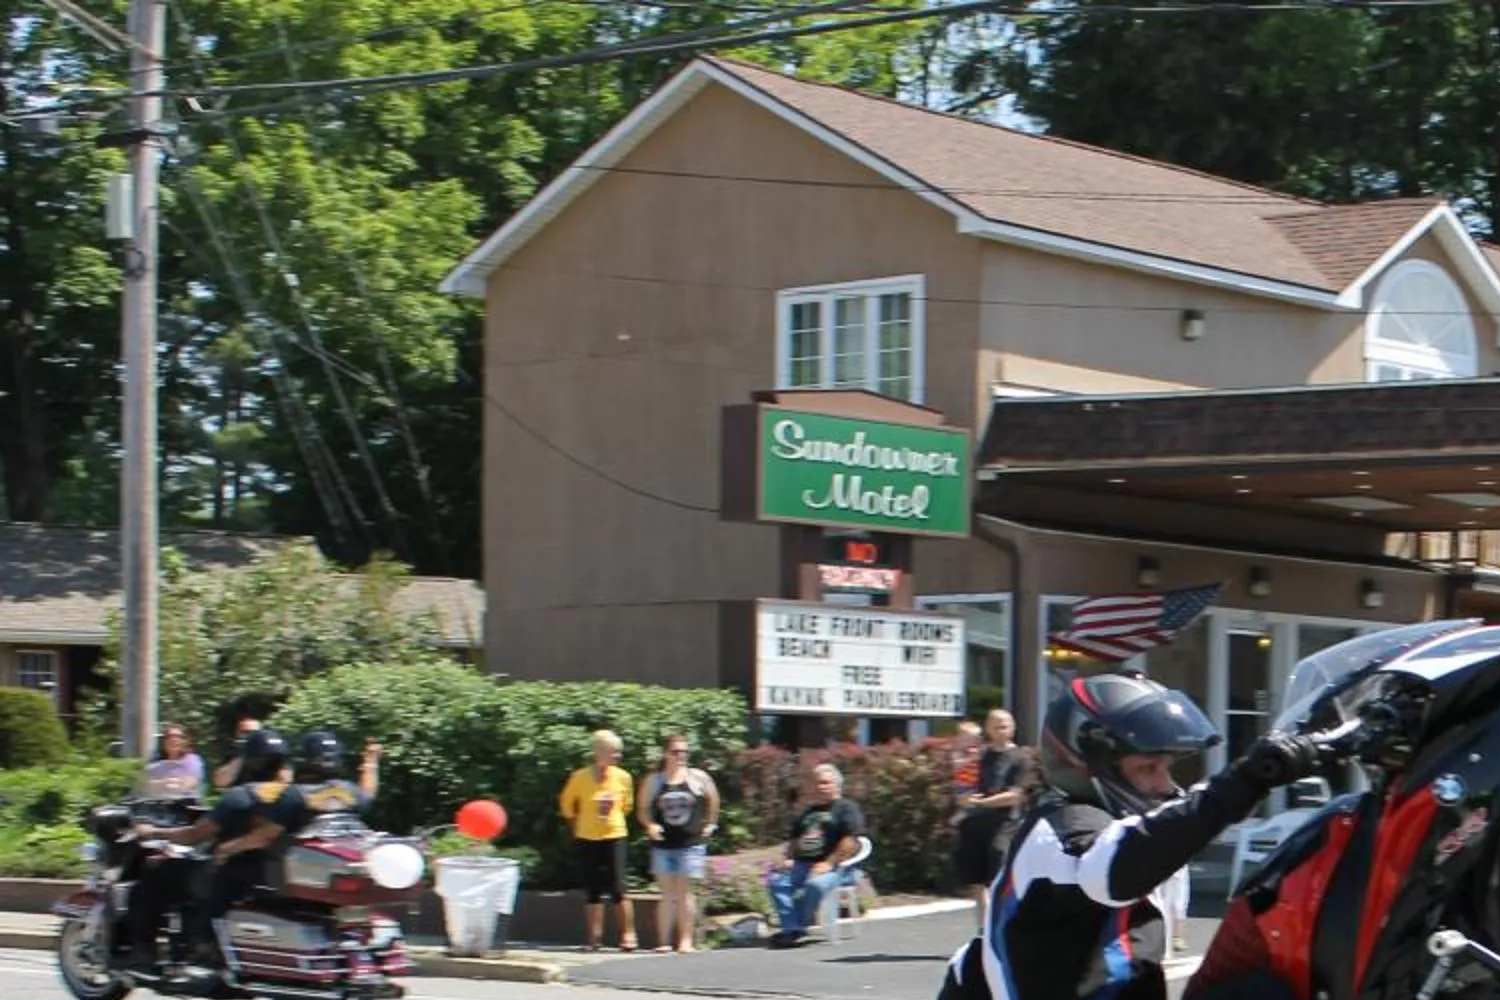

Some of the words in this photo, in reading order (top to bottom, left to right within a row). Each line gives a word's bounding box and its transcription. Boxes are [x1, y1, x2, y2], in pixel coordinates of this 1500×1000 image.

[771, 419, 959, 476] Sundowner
[802, 474, 929, 518] Motel
[775, 614, 819, 635] LAKE
[831, 616, 885, 638] FRONT
[900, 620, 956, 643] ROOMS
[779, 638, 830, 658] BEACH
[841, 665, 883, 686] FREE
[769, 687, 825, 705] KAYAK
